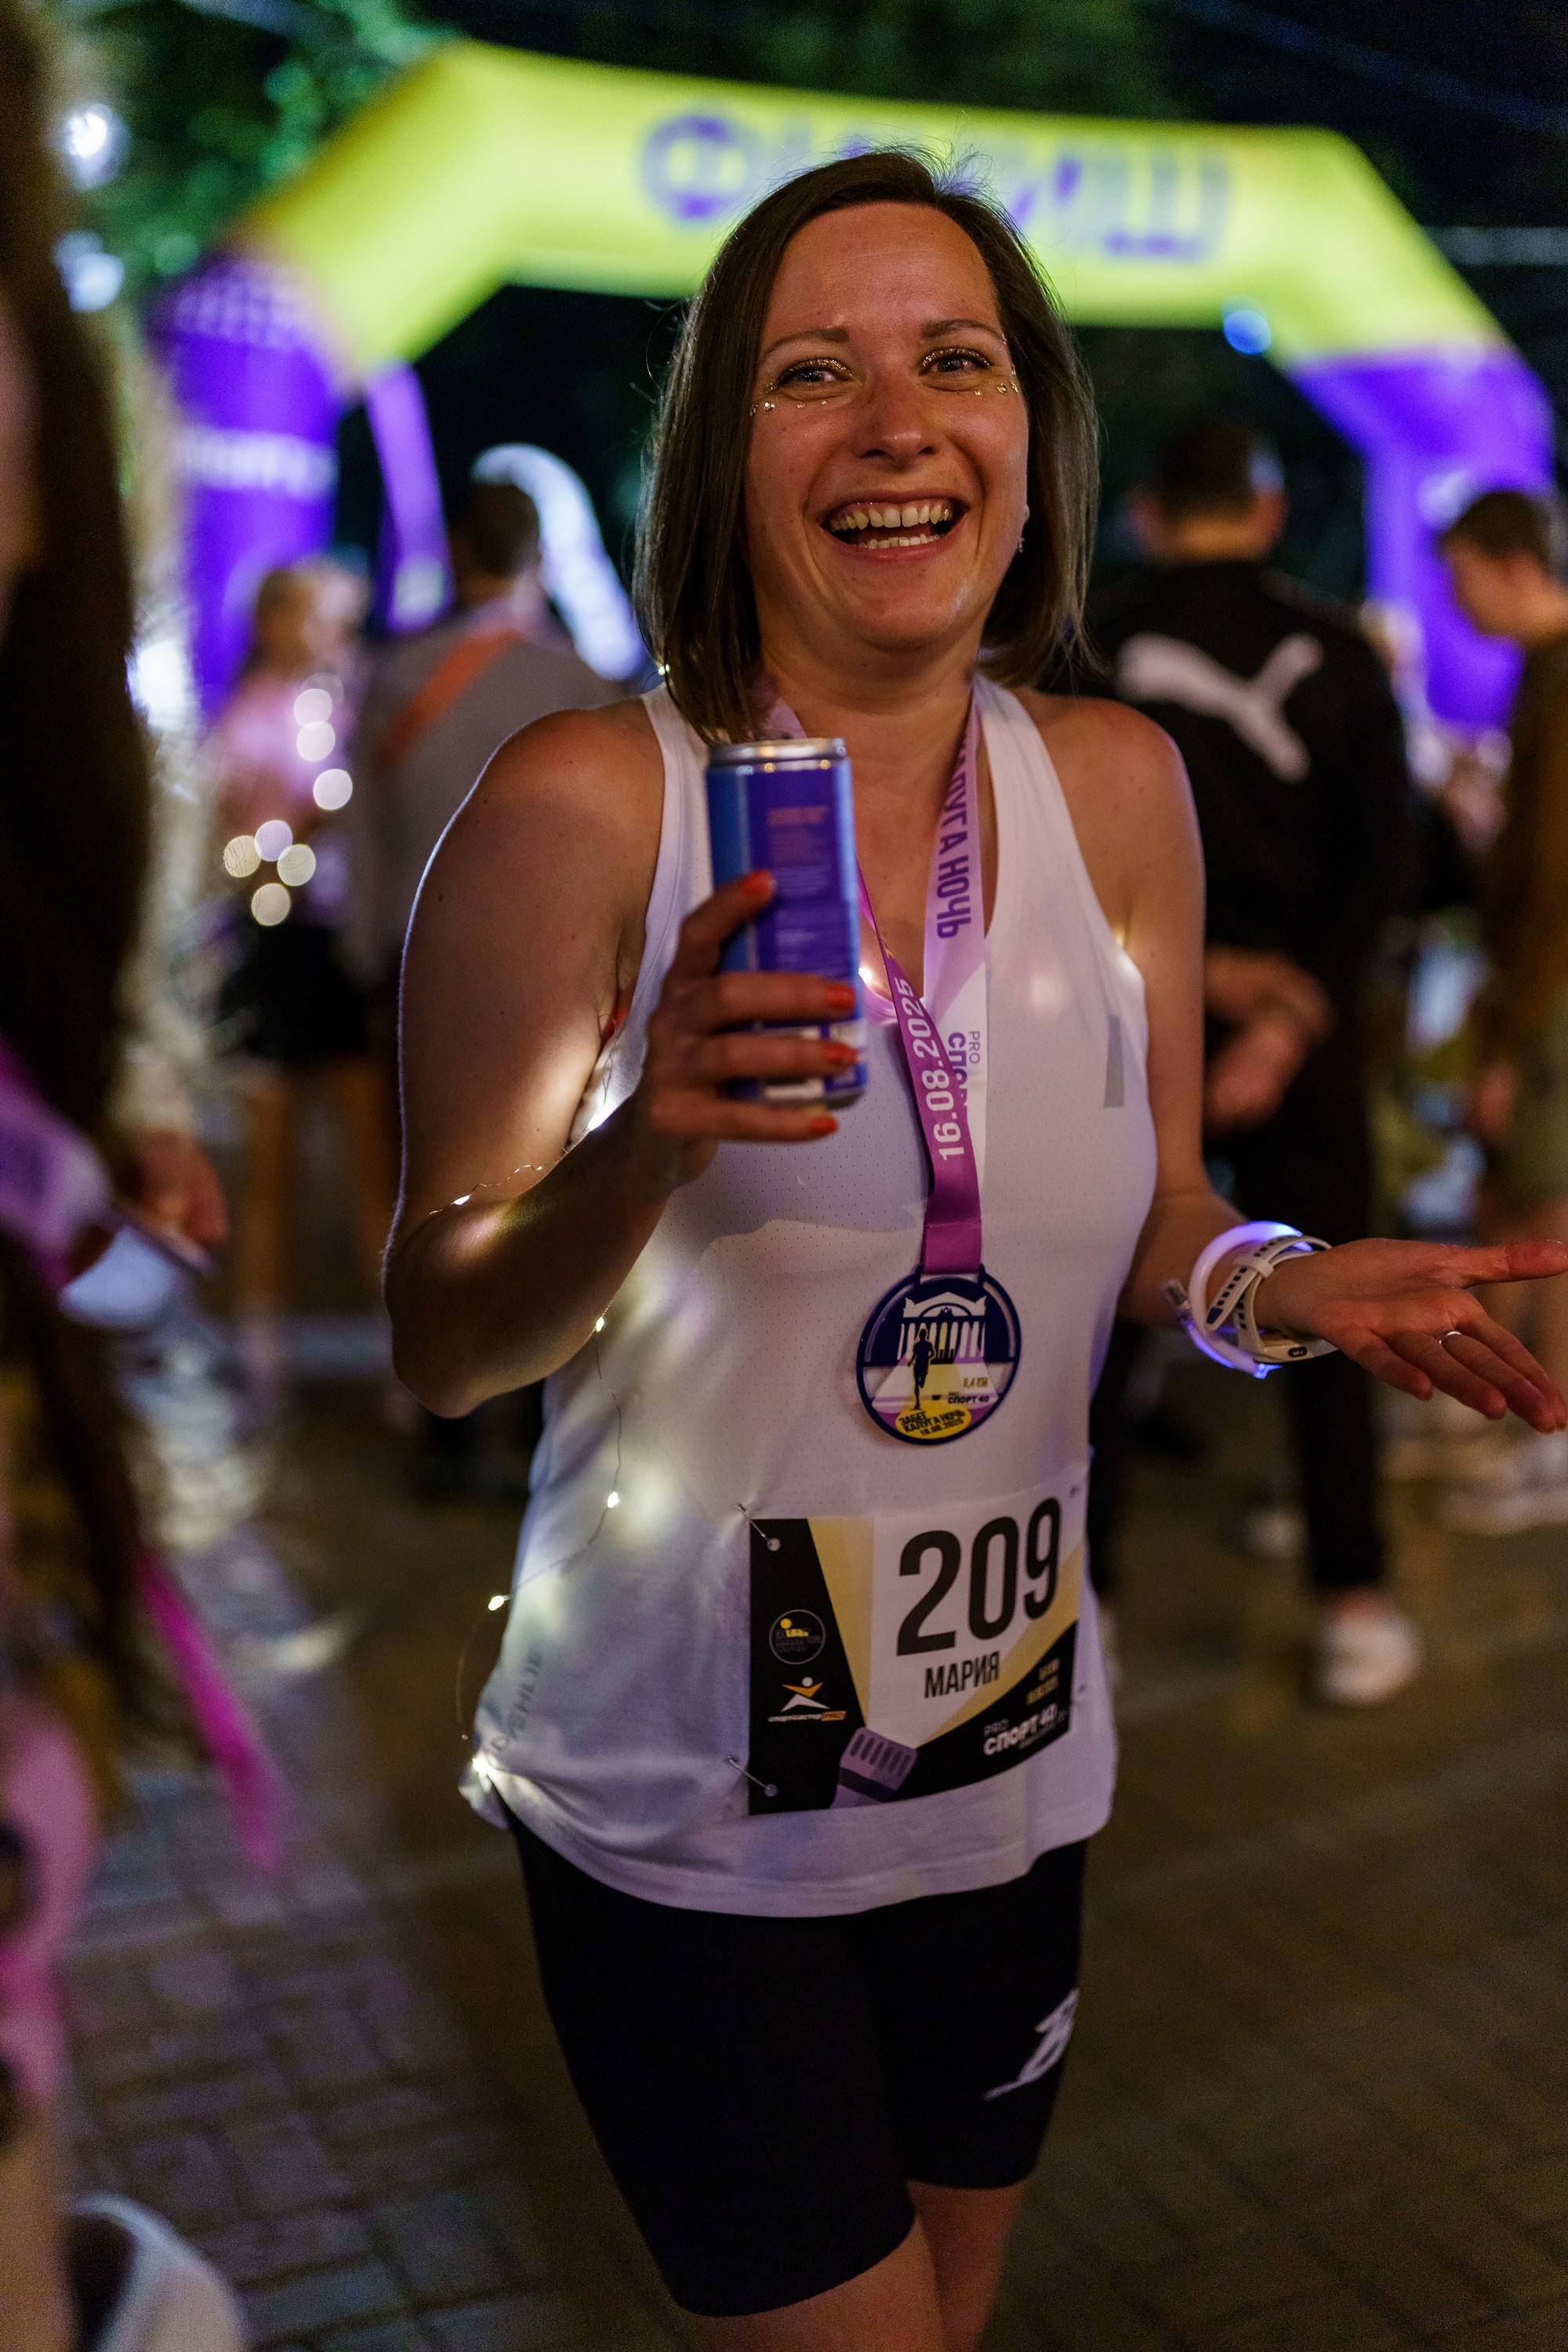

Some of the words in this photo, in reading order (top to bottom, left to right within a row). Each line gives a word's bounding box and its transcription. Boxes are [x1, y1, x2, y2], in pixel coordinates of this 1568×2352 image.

[936, 855, 971, 939] НОЧЬ
[894, 976, 965, 1161] 16.08.2025
[969, 1030, 981, 1065] PRO
[948, 1396, 977, 1404] СПОРТ
[897, 1497, 1061, 1657] 209
[924, 1650, 1000, 1700] МАРИЯ
[982, 1712, 1040, 1756] СПОРТ
